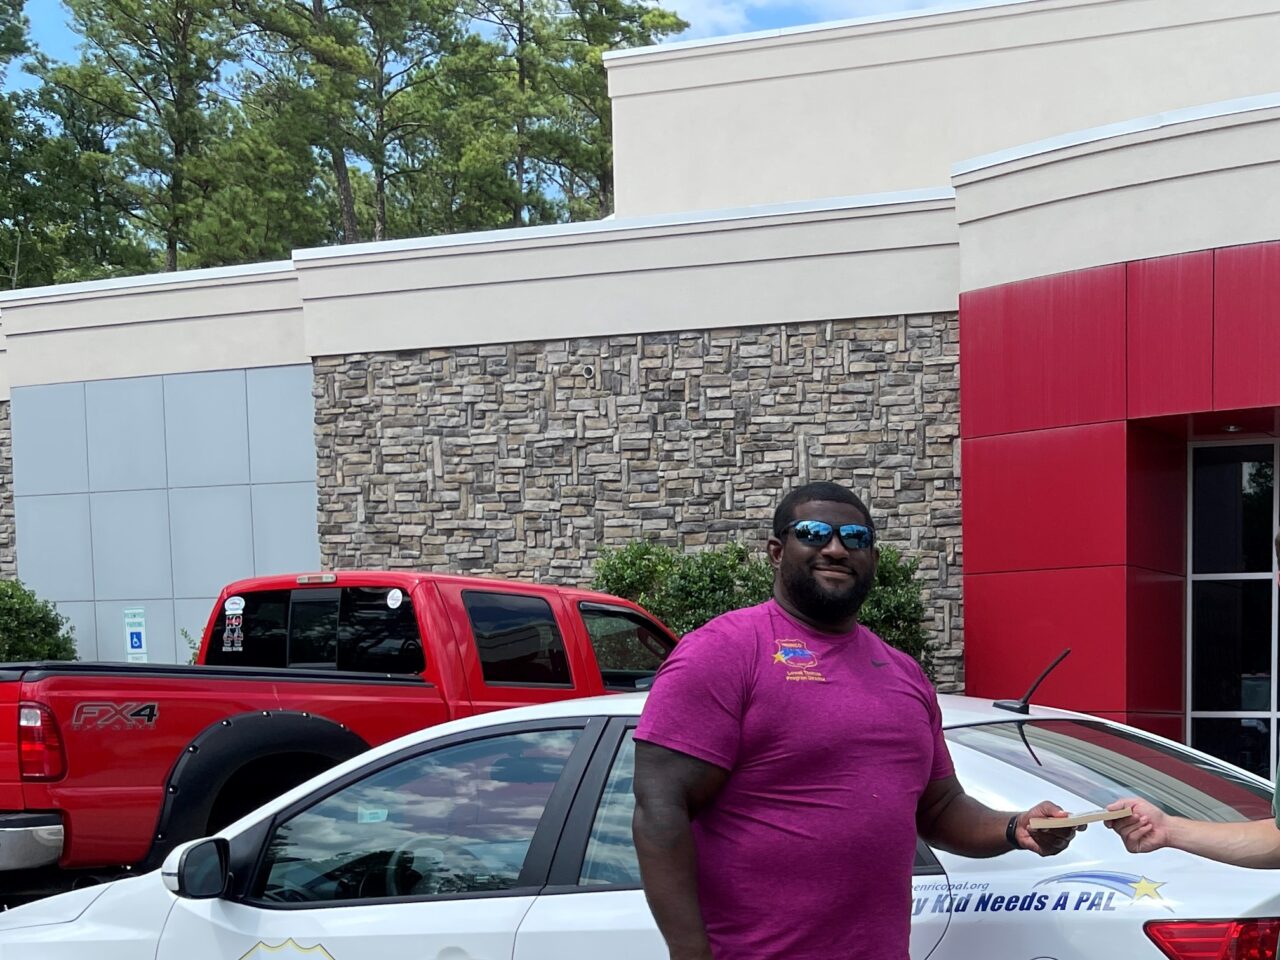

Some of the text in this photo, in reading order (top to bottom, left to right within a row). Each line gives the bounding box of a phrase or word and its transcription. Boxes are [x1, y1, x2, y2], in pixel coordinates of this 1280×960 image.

[72, 701, 159, 725] FX4
[911, 881, 990, 892] enricopal.org
[931, 893, 973, 913] Kid
[974, 891, 1050, 912] Needs
[1052, 891, 1070, 911] A
[1074, 891, 1117, 912] PAL
